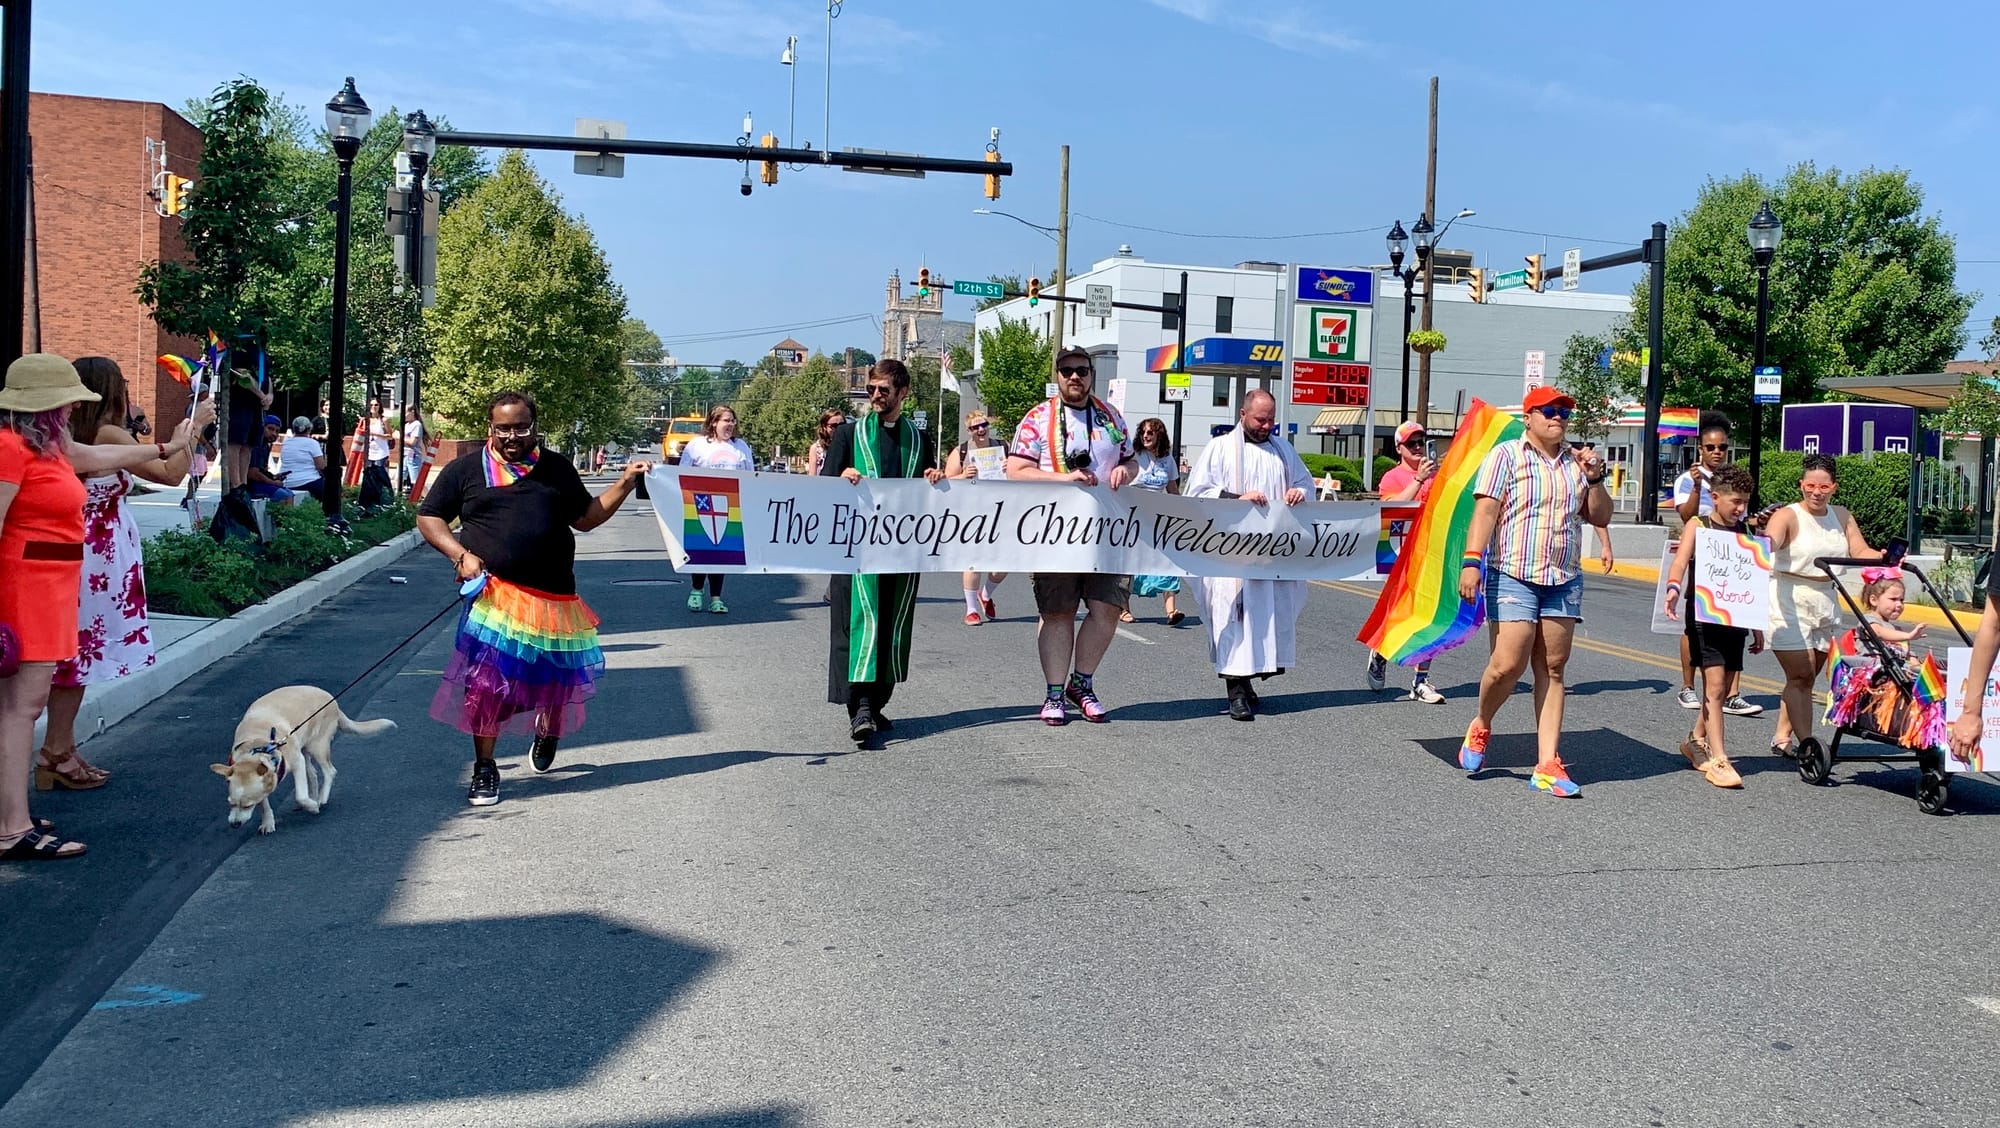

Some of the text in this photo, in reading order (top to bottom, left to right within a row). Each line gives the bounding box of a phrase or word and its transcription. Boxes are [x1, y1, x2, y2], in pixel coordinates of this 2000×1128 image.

[1318, 282, 1354, 291] SUNOCO
[1497, 275, 1523, 288] Hamilton
[959, 283, 998, 295] 12th St
[767, 497, 1360, 558] The Episcopal Church Welcomes You
[1715, 580, 1754, 604] Love
